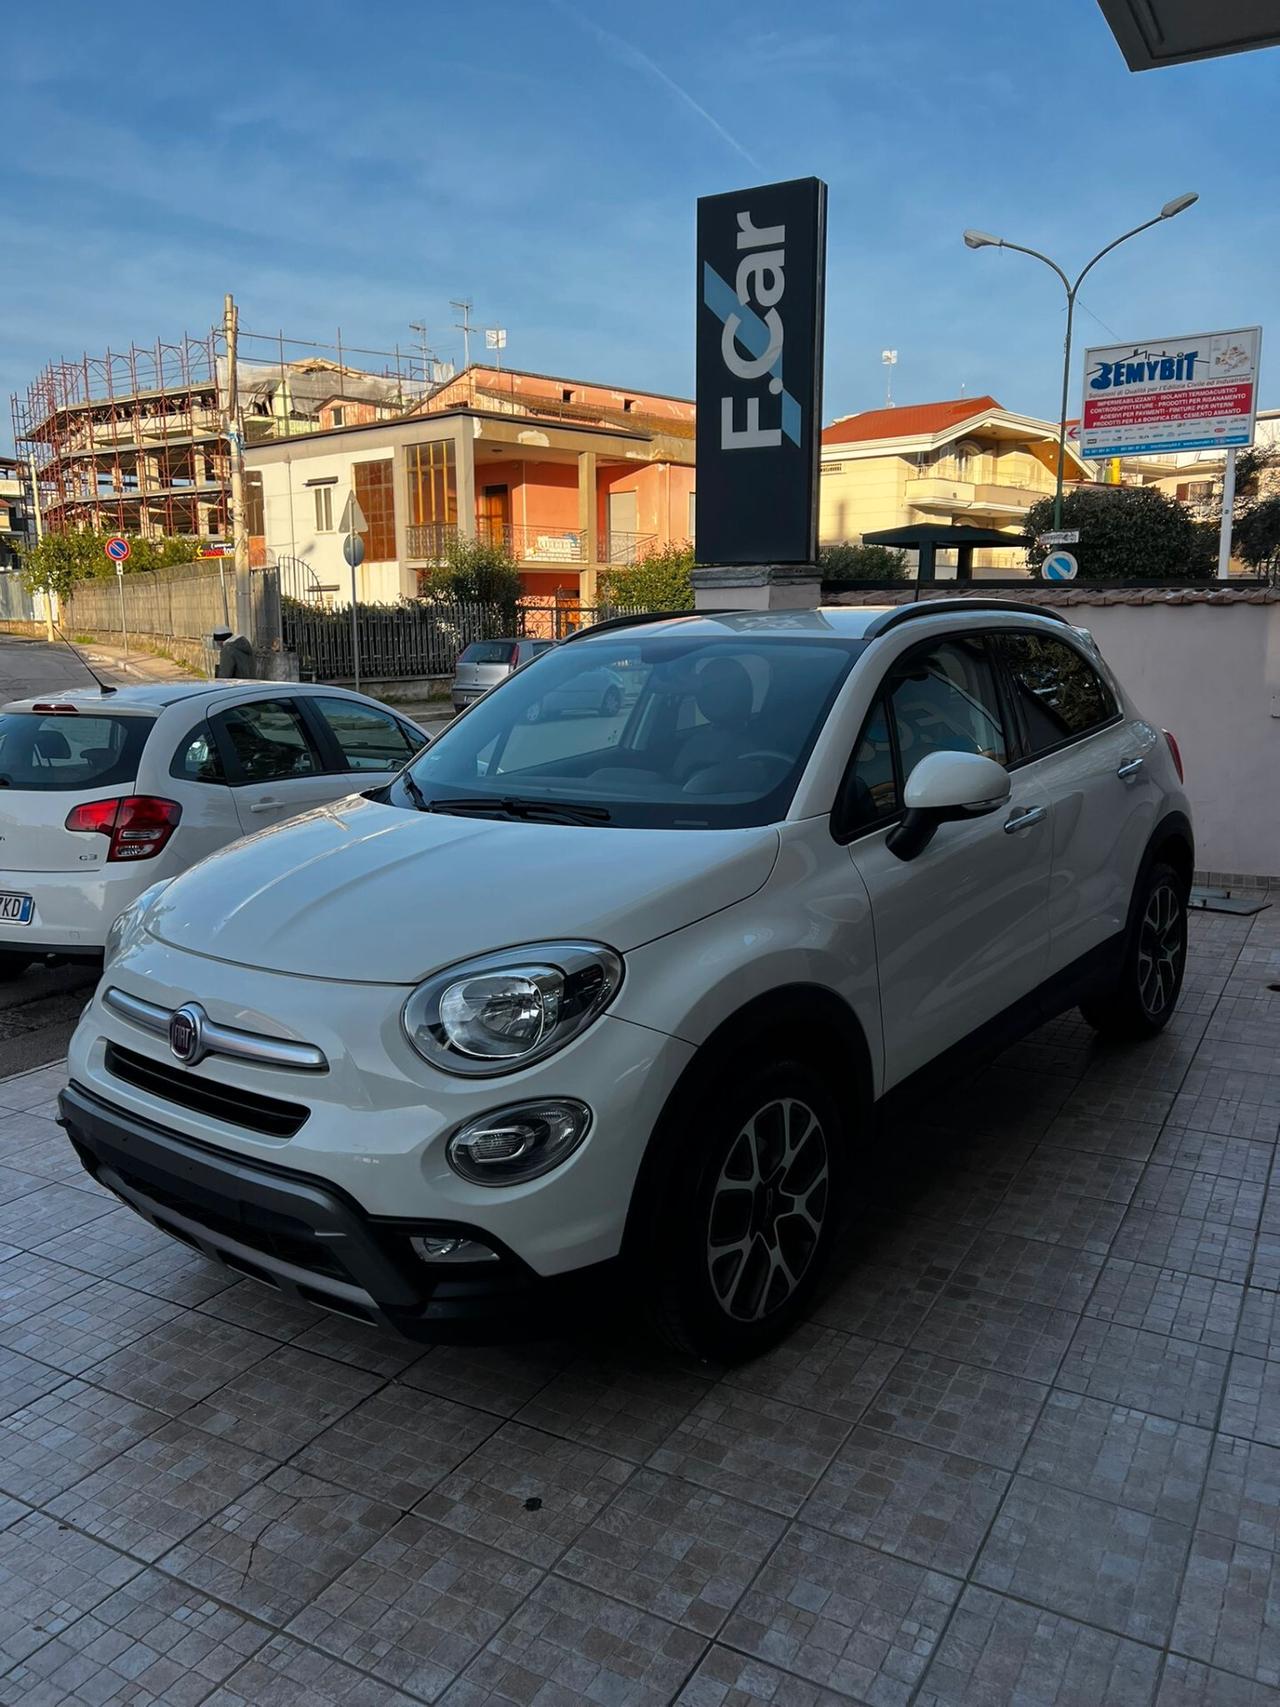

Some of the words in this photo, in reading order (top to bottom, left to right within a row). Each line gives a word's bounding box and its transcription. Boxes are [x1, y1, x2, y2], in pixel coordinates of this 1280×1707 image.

[721, 211, 786, 450] F.Car
[1097, 395, 1157, 407] IMPERMEABILIZZANTI
[1160, 392, 1188, 400] ISOLANTI
[1189, 387, 1237, 398] TERMOACUSTICI
[1158, 399, 1188, 408] PRODOTTI
[1202, 393, 1246, 403] RISANAMENTO
[1093, 419, 1121, 427] PRODOTTI
[1143, 414, 1170, 422] BONIFICA
[1183, 411, 1213, 419] CEMENTO
[1213, 407, 1242, 416] AMIANTO
[1100, 412, 1121, 420] ADESIVI
[1135, 408, 1165, 417] PAVIMENTI
[1169, 405, 1196, 413] FINITURE
[1210, 401, 1234, 409] INTERNI
[79, 853, 98, 861] C3
[174, 1024, 191, 1049] FIAT
